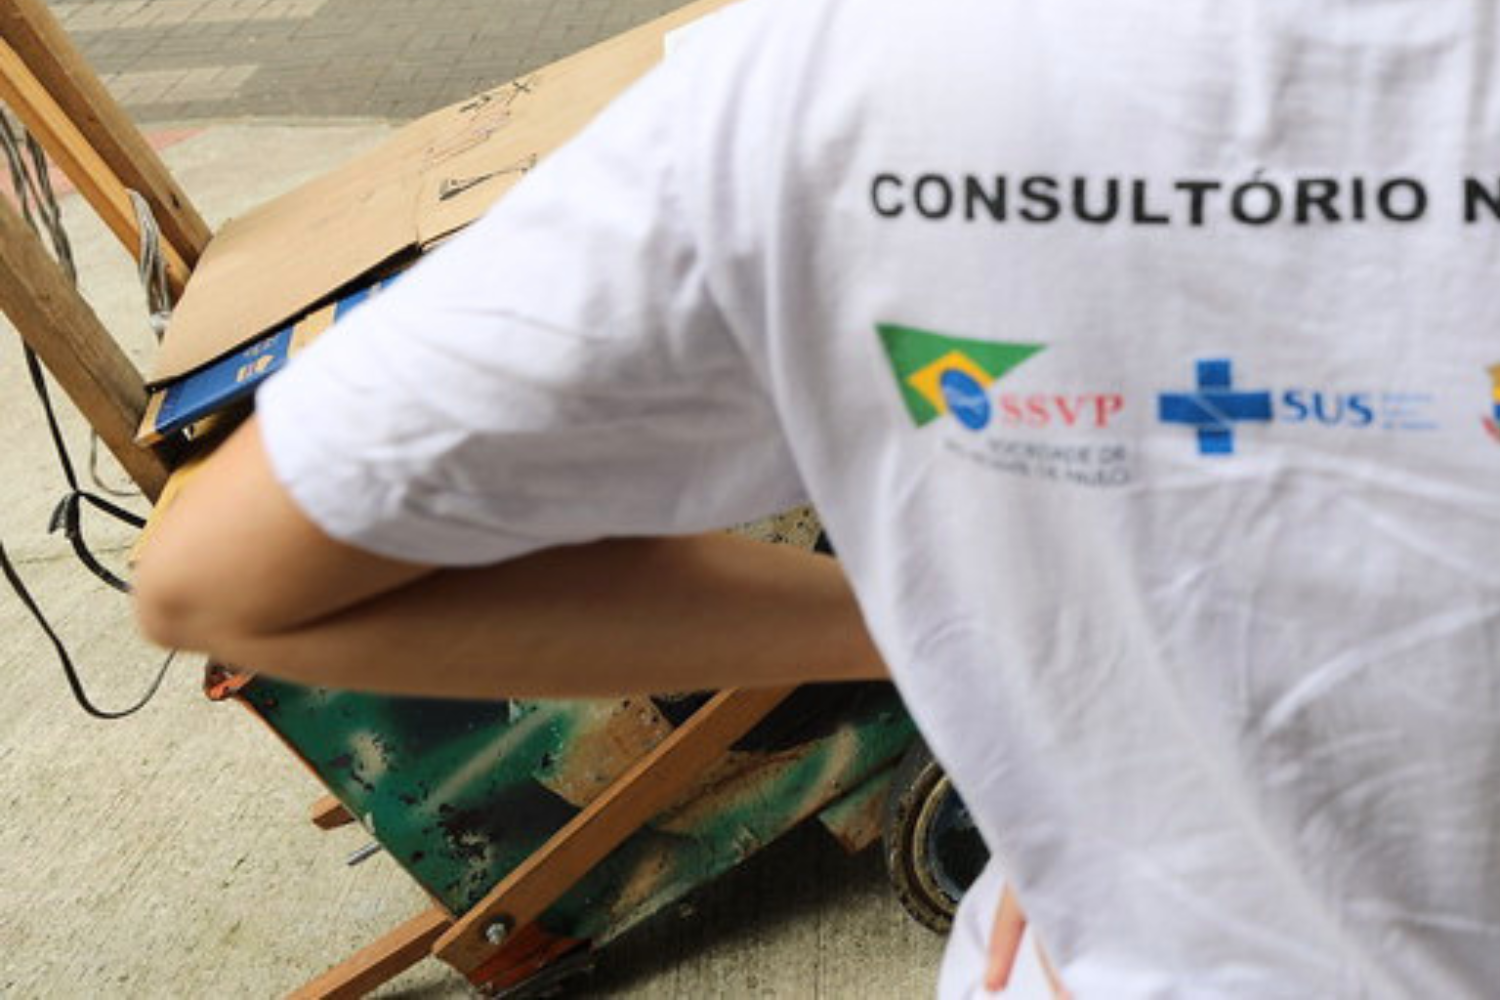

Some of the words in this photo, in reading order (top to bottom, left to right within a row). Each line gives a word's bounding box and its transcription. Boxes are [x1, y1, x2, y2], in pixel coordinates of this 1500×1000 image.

[869, 166, 1428, 226] CONSULTÓRIO
[1000, 391, 1124, 429] SSVP
[1283, 388, 1373, 429] SUS
